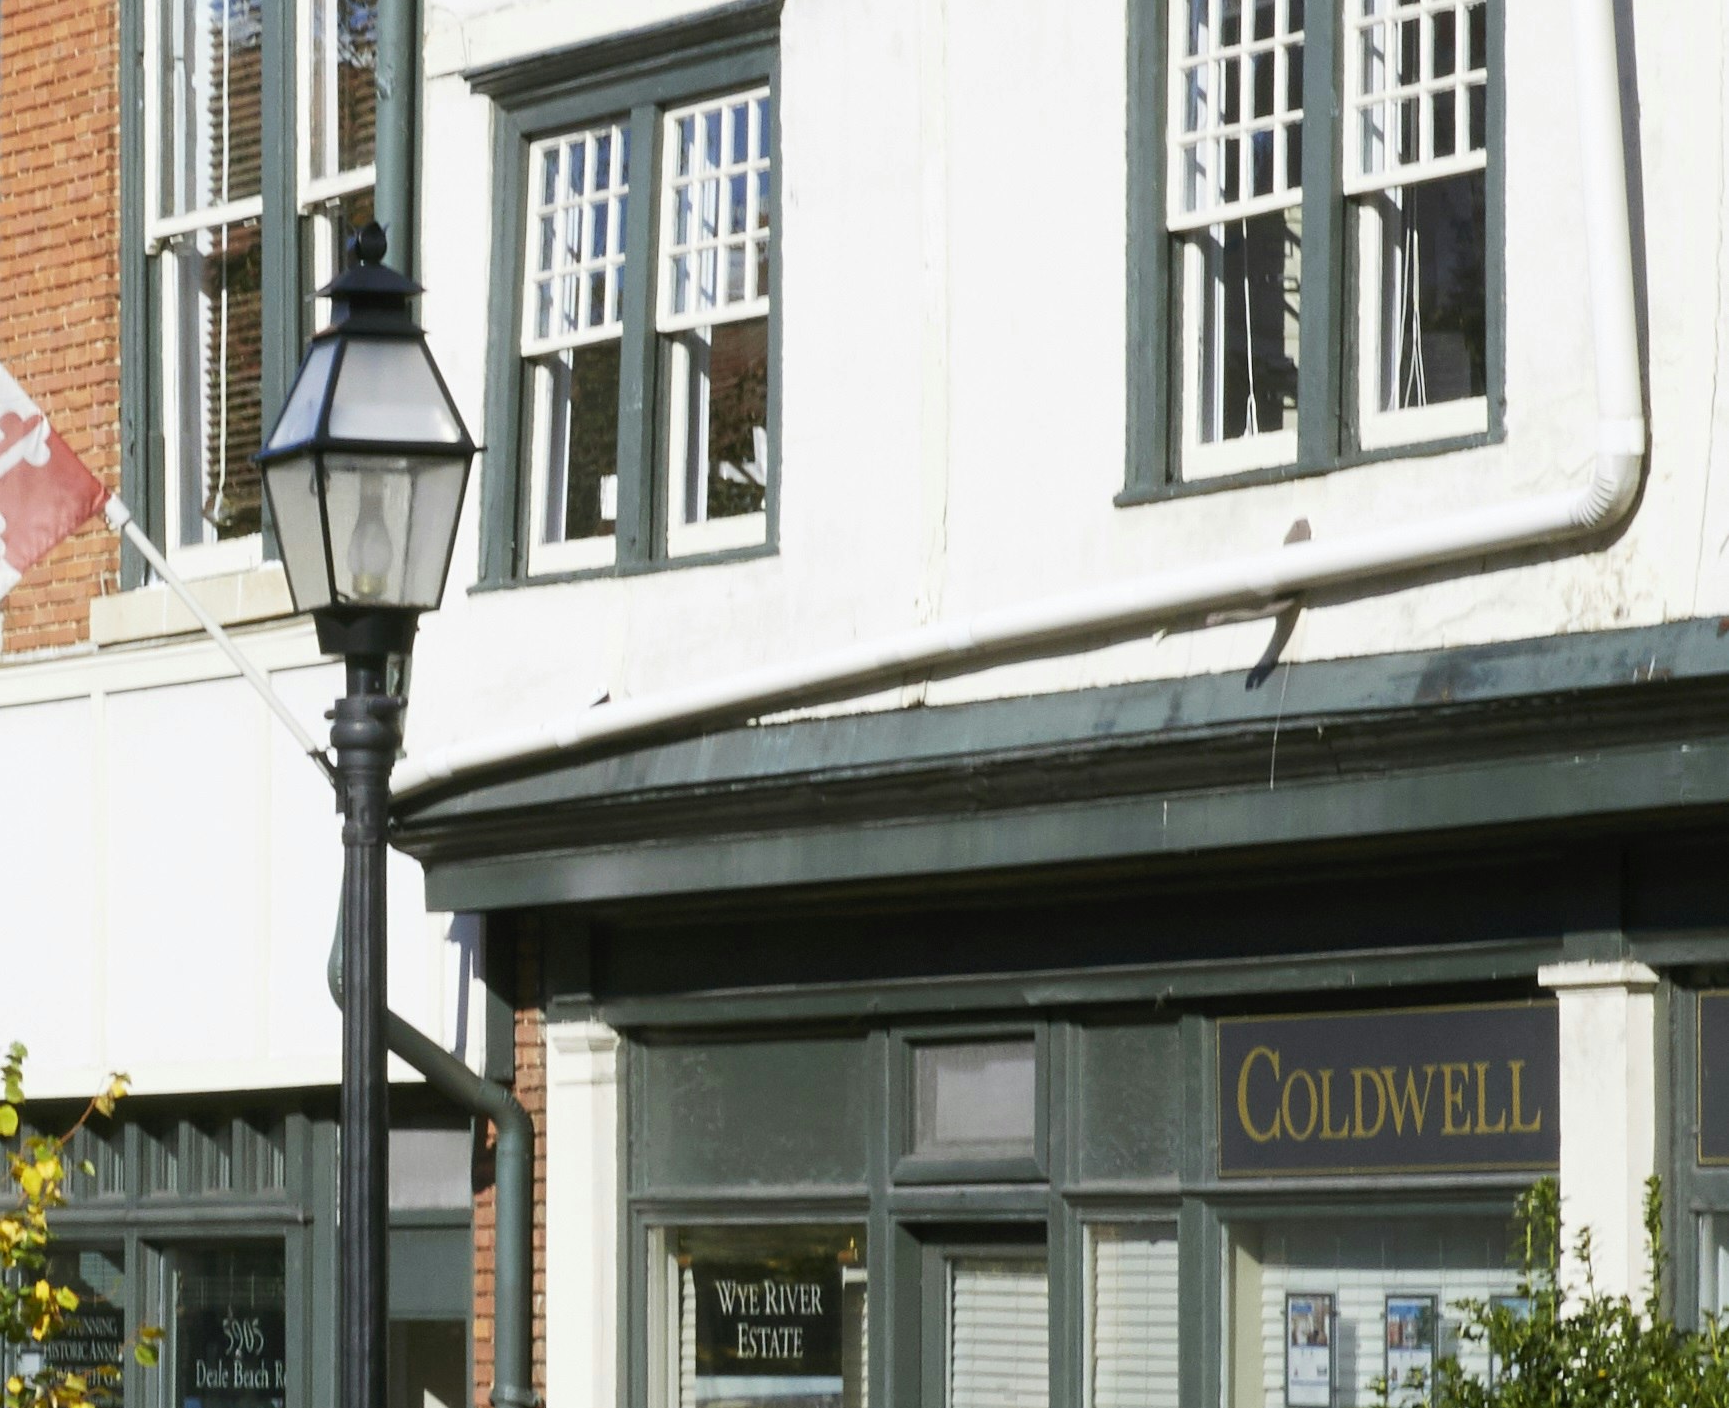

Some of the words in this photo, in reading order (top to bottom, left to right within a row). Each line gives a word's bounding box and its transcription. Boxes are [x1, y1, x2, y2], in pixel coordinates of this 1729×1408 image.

[1237, 1045, 1542, 1143] COLDWELL
[715, 1279, 760, 1315] WYE
[764, 1279, 823, 1315] RIVER
[737, 1322, 803, 1359] ESTATE
